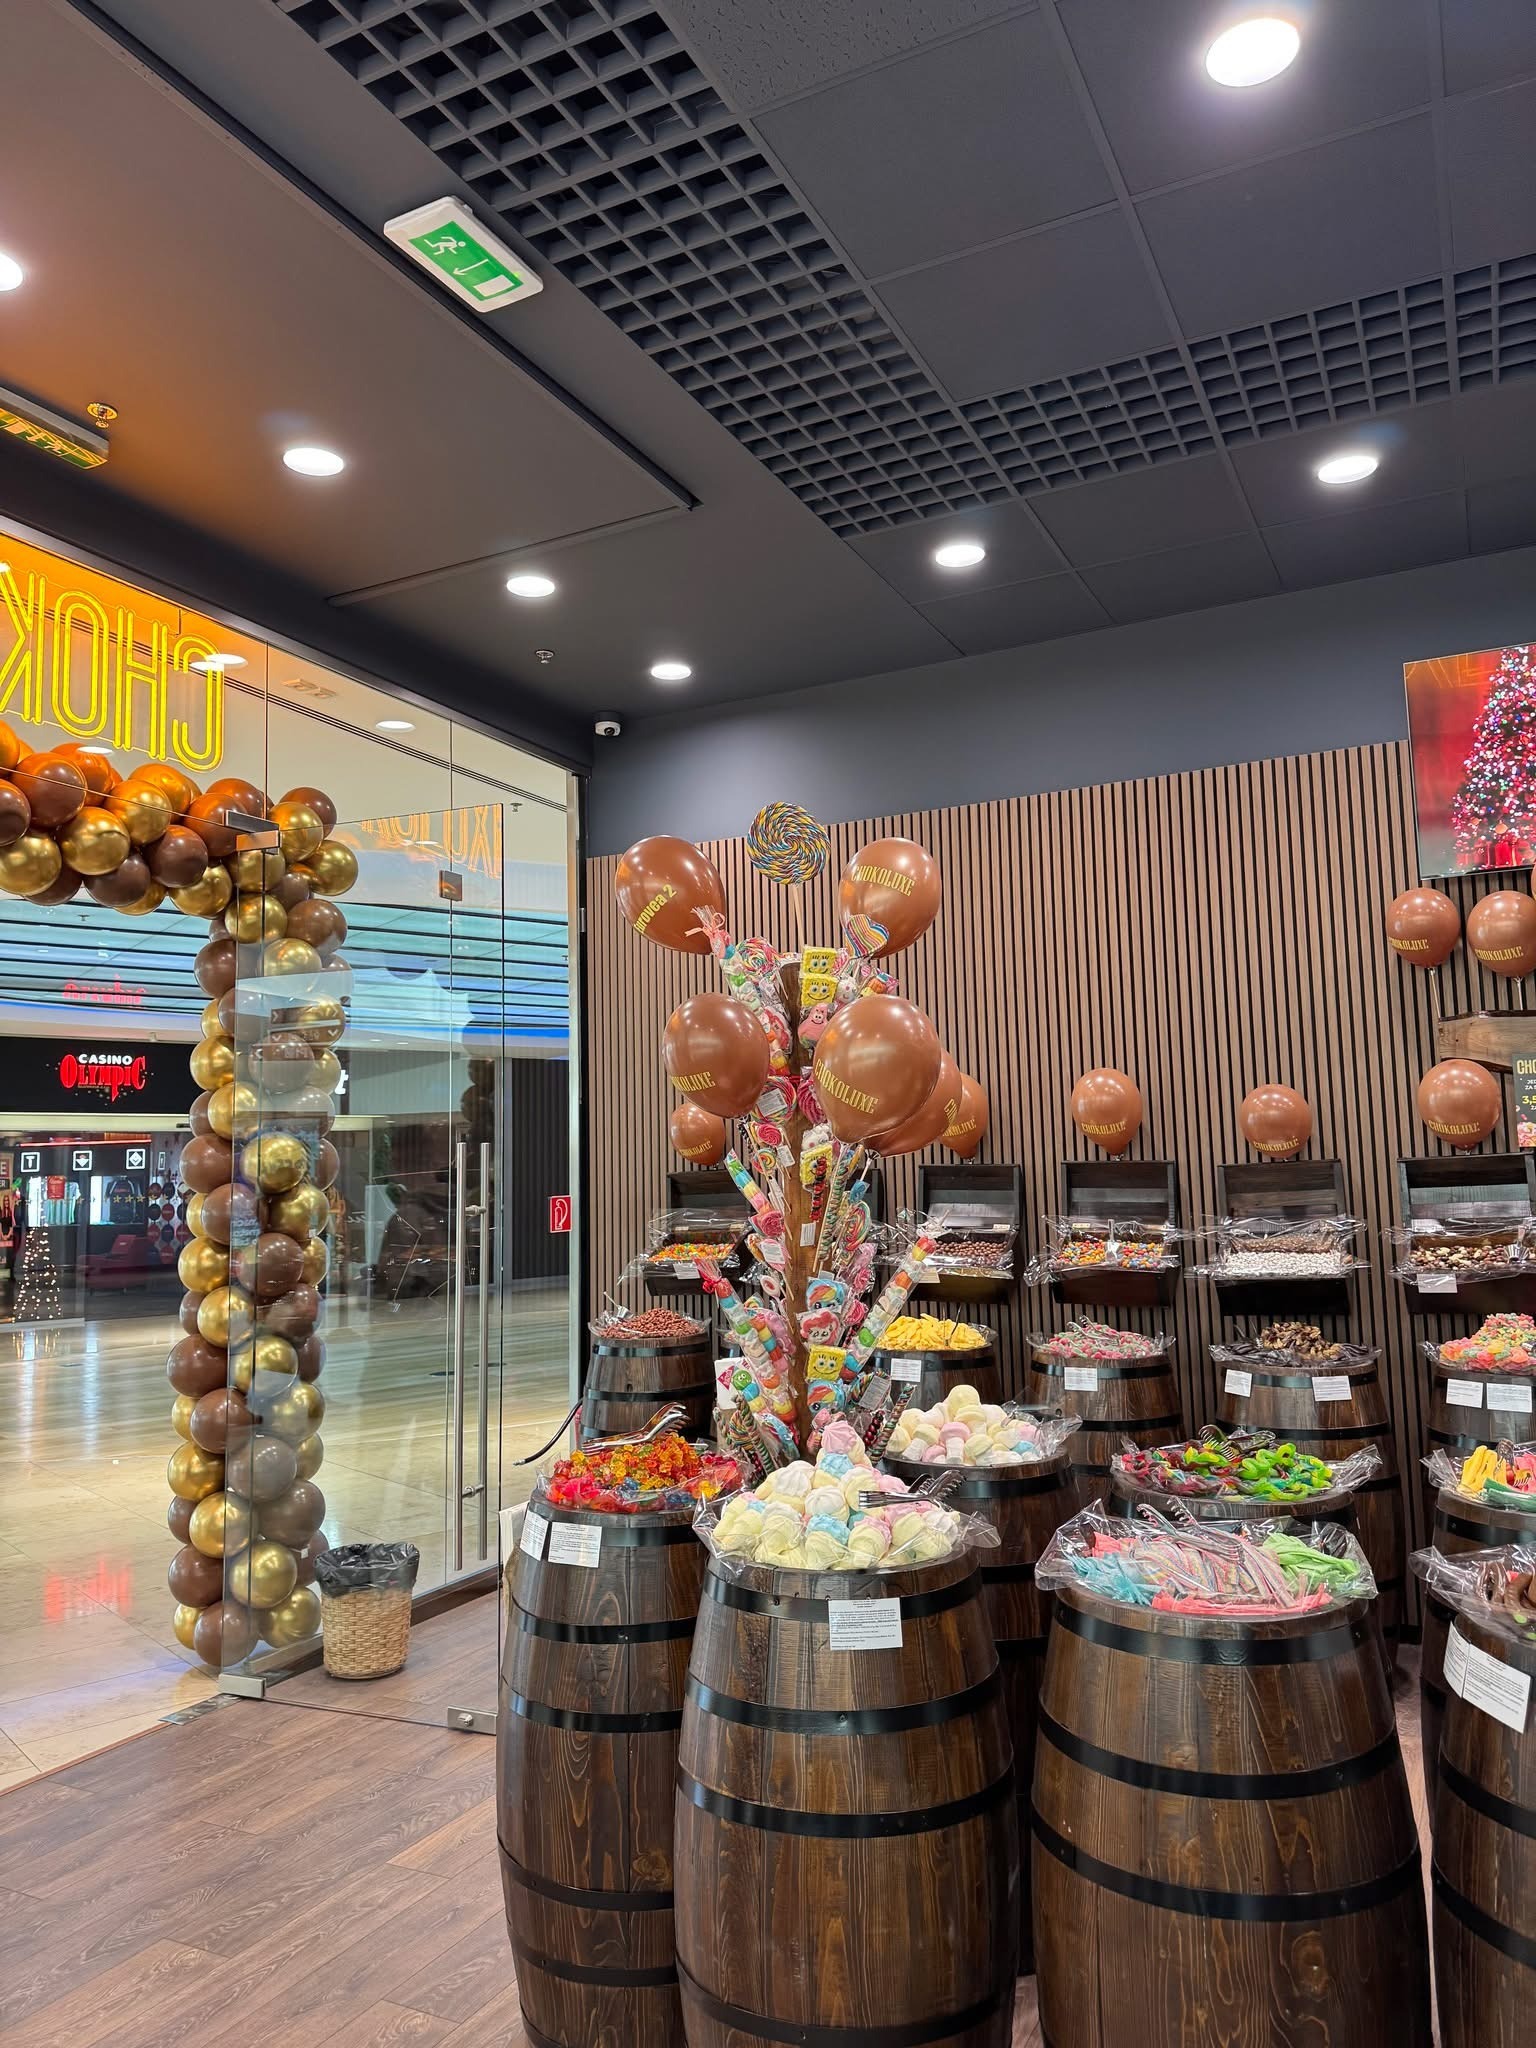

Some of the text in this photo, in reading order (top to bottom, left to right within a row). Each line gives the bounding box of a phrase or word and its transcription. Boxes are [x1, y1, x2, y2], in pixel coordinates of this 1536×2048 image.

[851, 864, 916, 897] CHOKOLUXE
[662, 883, 677, 898] 2
[1475, 945, 1524, 961] CHOKOLUXE
[78, 1053, 133, 1065] CASINO
[814, 1058, 880, 1114] CHOKOLUXE
[1081, 1120, 1126, 1135] CHOKOLUXE
[1428, 1119, 1481, 1135] CHOKOLUXE
